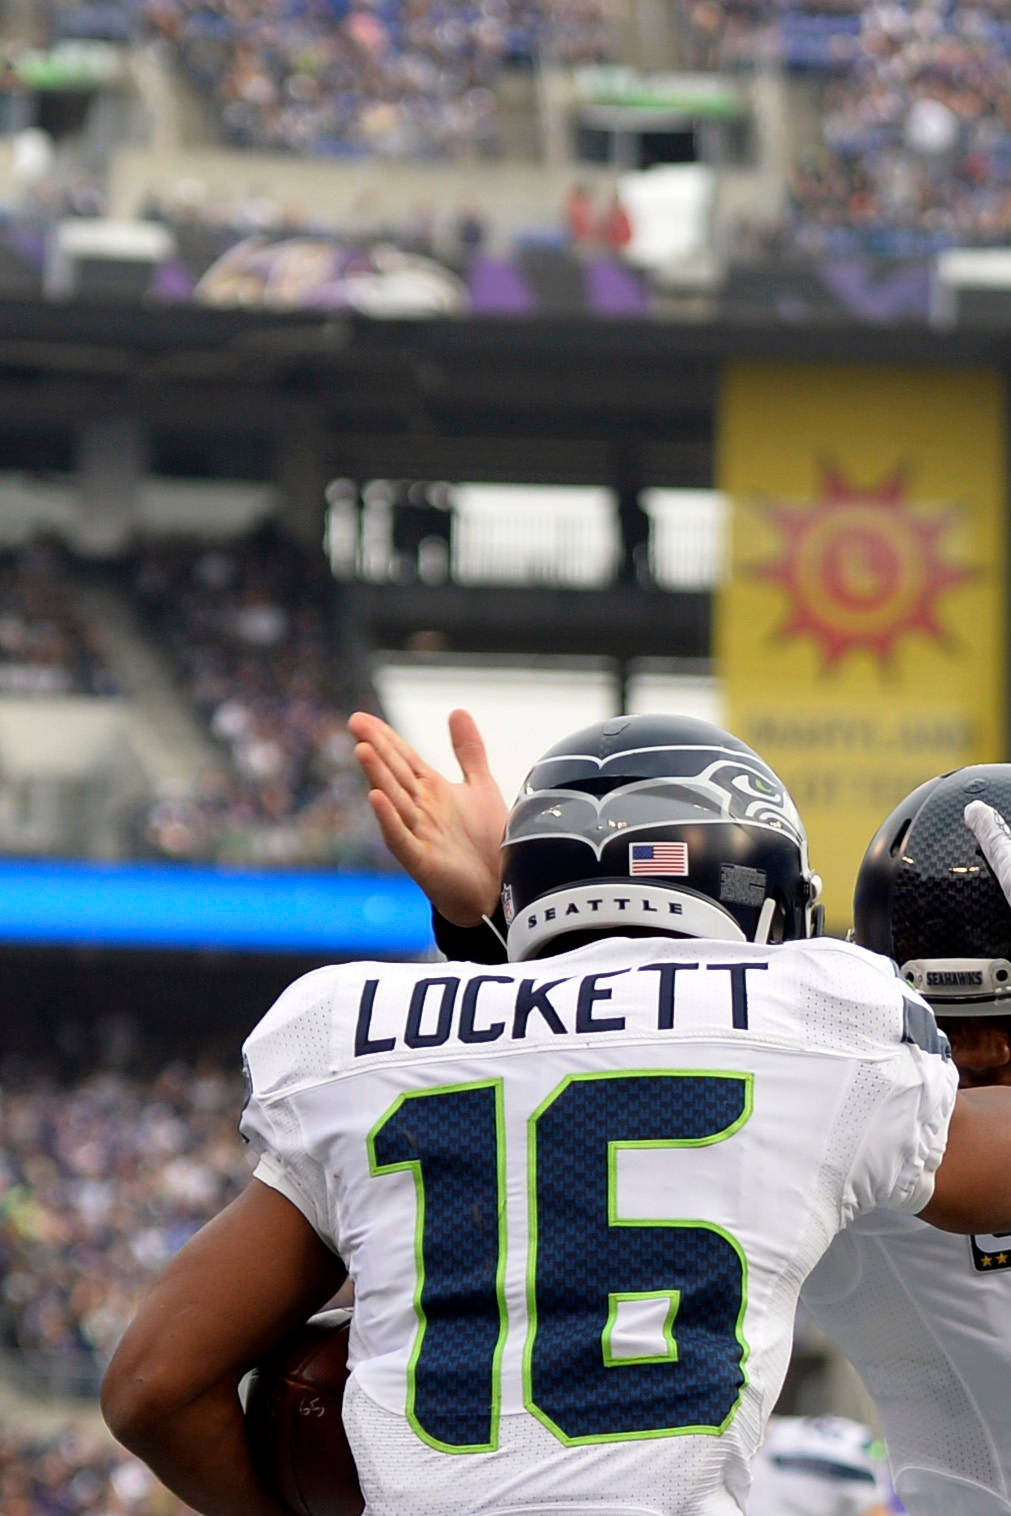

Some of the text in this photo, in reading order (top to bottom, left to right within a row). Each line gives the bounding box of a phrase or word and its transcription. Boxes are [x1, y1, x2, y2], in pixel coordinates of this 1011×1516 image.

[527, 898, 684, 929] SEATTLE
[354, 962, 769, 1058] LOCKETT
[926, 970, 983, 987] SEAHAWKS
[366, 1067, 755, 1456] 16
